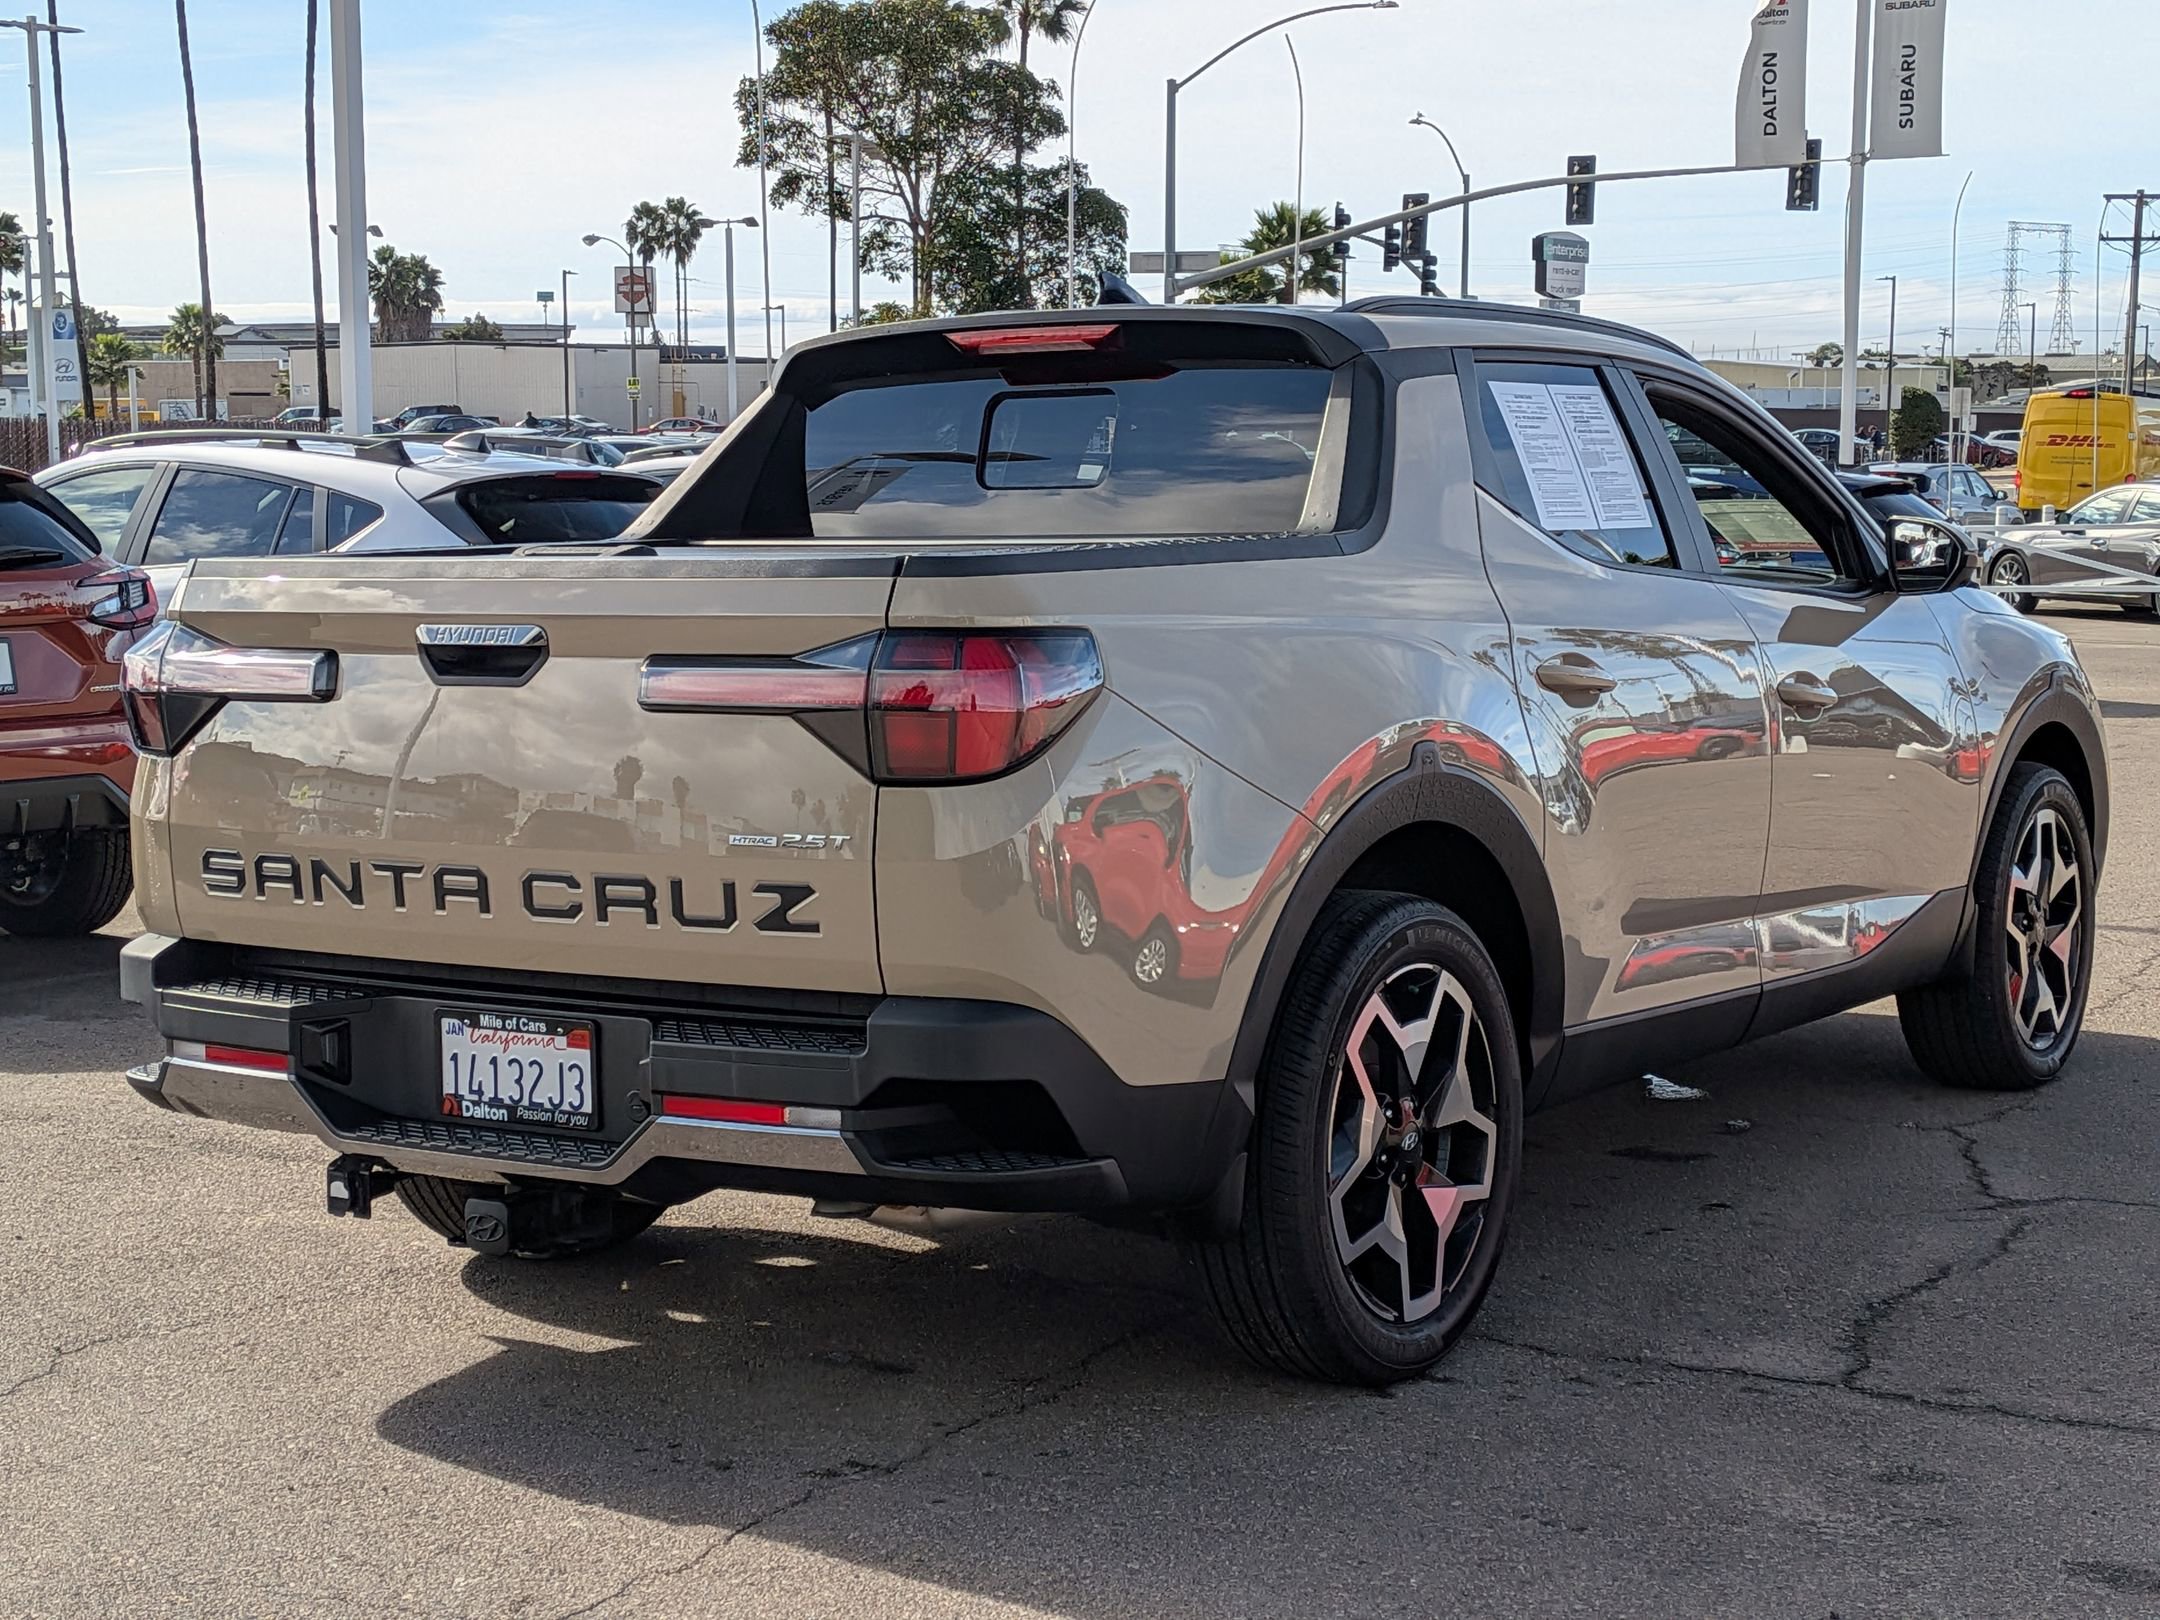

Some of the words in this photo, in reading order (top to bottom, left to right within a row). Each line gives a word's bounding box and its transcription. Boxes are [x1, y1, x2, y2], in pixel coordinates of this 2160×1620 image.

[1885, 0, 1936, 11] SUBARU
[1762, 52, 1778, 136] DALTON
[1899, 44, 1917, 129] SUBARU
[2047, 434, 2105, 448] DHL
[434, 626, 518, 644] HYUNDAI
[731, 835, 776, 846] HTRAC
[201, 847, 495, 919] SANTA
[520, 868, 823, 937] CRUZ
[446, 1021, 464, 1036] JAN
[479, 1014, 503, 1029] Mile
[505, 1016, 517, 1030] of
[519, 1018, 547, 1033] Cars
[469, 1027, 567, 1054] California
[449, 1051, 585, 1112] 14132J3
[461, 1100, 508, 1122] Dalton
[516, 1105, 552, 1123] Passion
[553, 1108, 569, 1124] for
[569, 1114, 589, 1127] you
